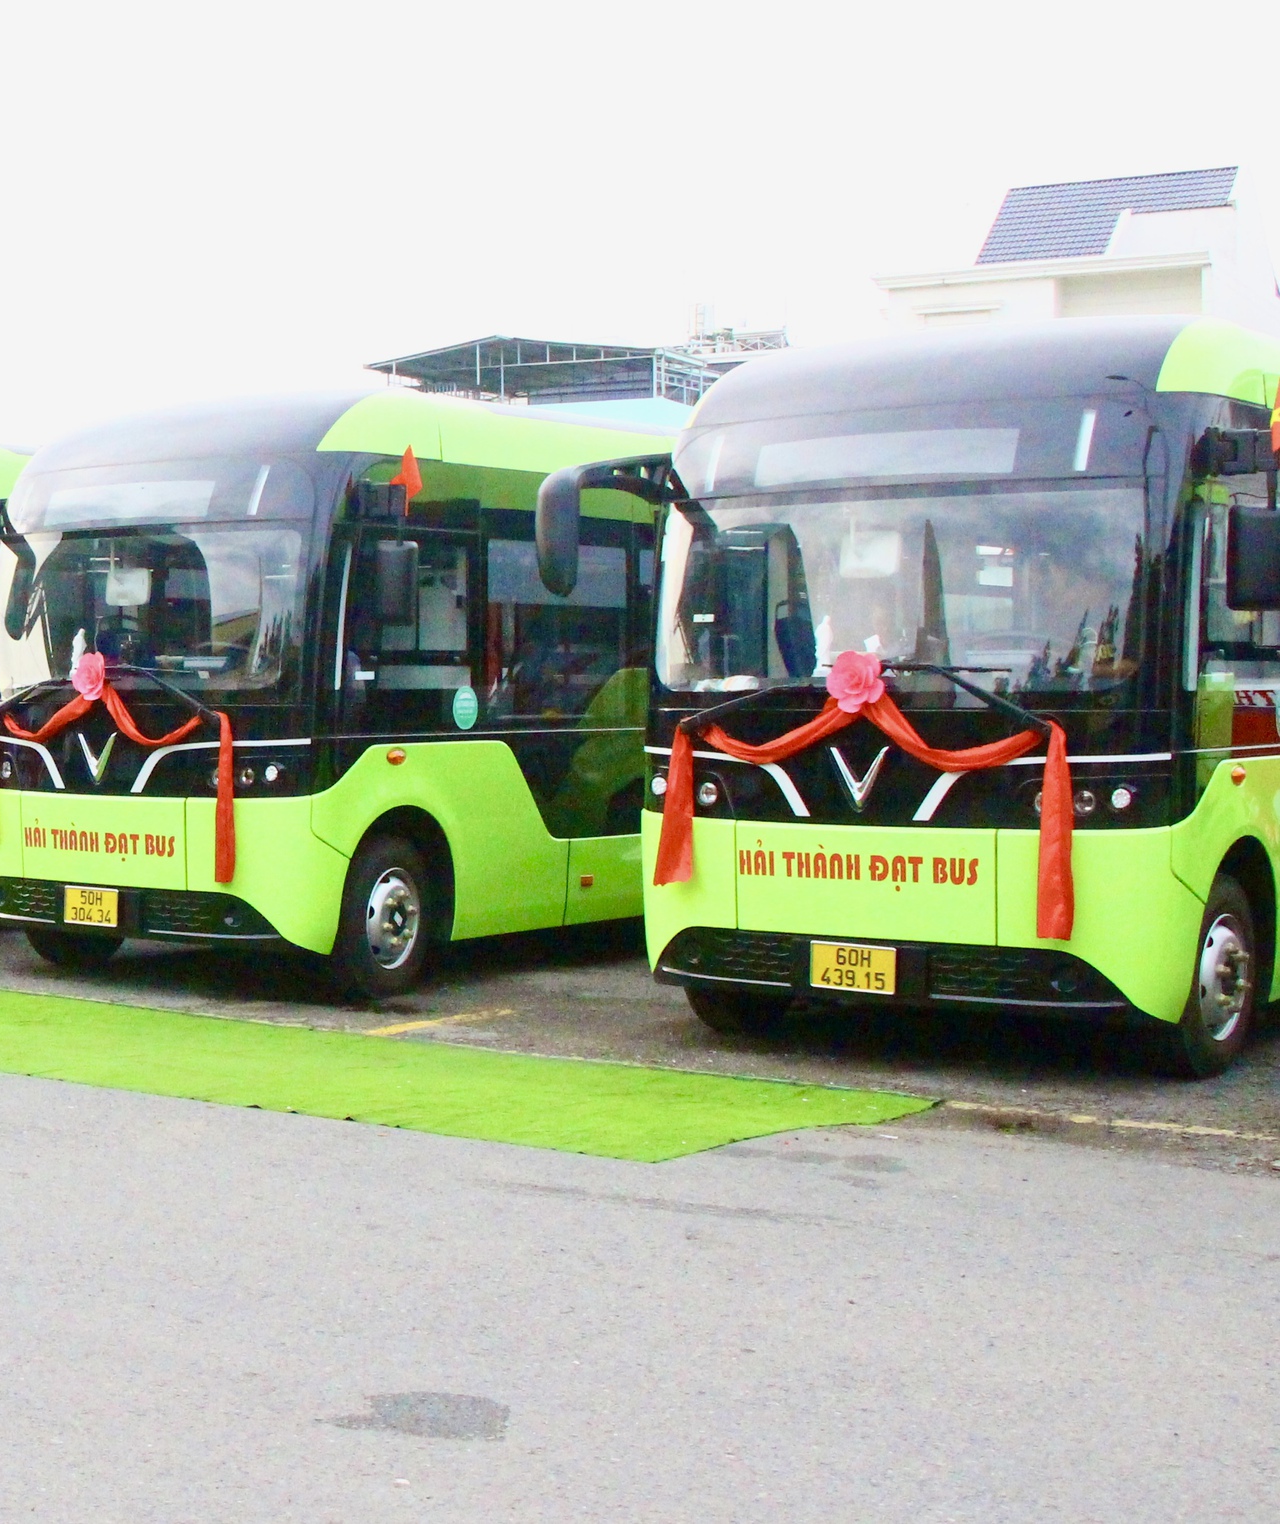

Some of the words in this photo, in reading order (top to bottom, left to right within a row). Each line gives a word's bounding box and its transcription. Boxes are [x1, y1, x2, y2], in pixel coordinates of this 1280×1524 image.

[24, 818, 47, 848] HẢI
[51, 822, 100, 853] THÀNH
[104, 832, 140, 862] ĐẠT
[145, 834, 176, 858] BUS
[738, 838, 776, 877] HẢI
[782, 844, 861, 881] THÀNH
[869, 854, 924, 892] ĐẠT
[932, 857, 980, 886] BUS
[80, 890, 104, 906] 50H
[71, 907, 112, 925] 304.34
[835, 947, 873, 969] 60H
[820, 969, 887, 992] 439.15
